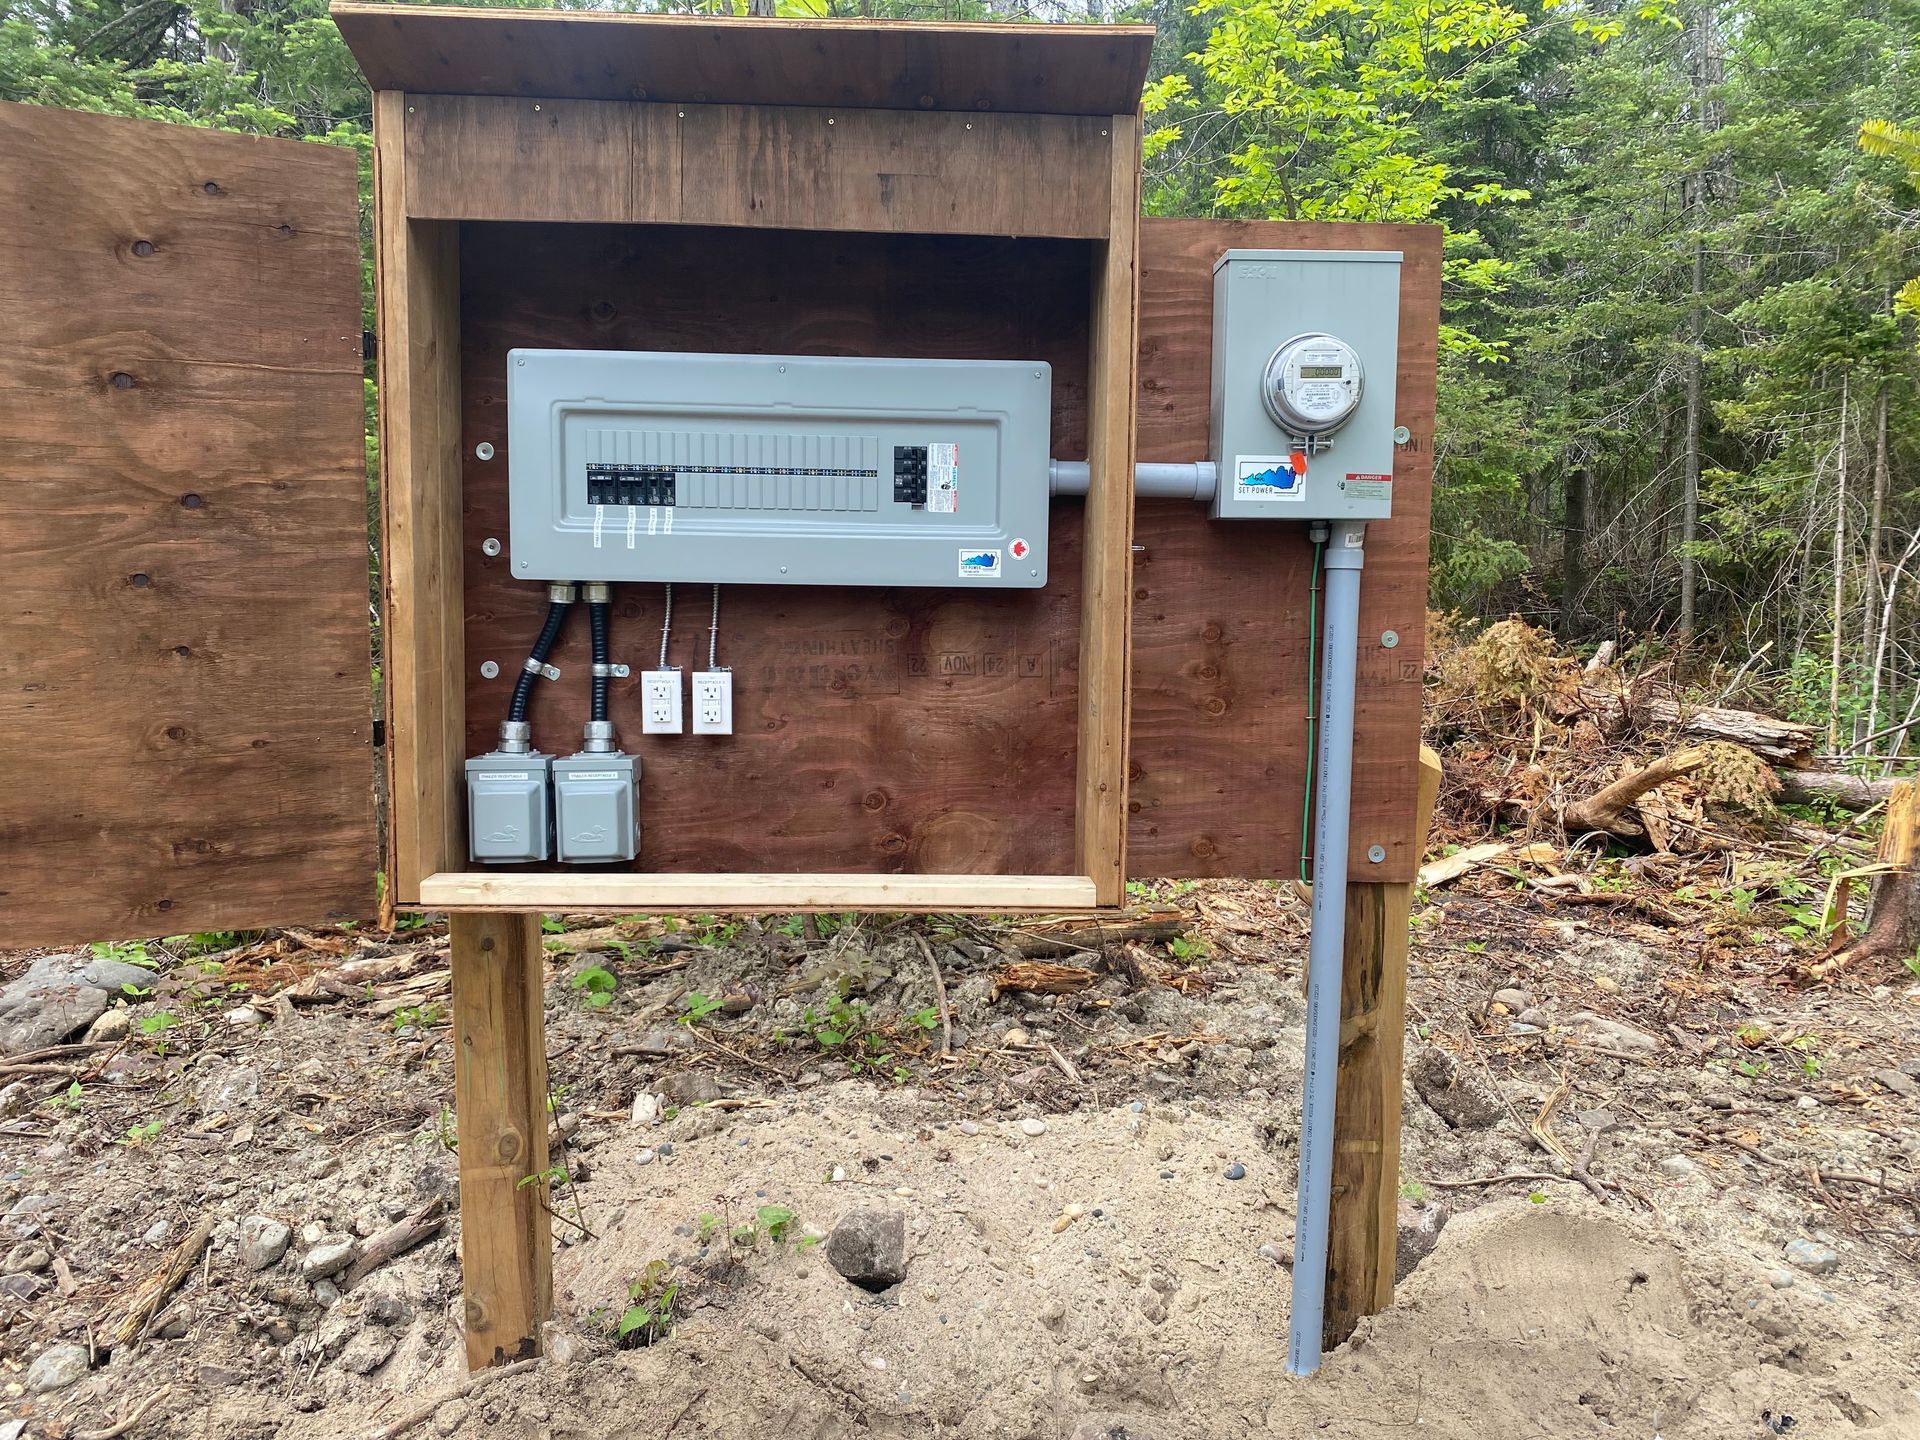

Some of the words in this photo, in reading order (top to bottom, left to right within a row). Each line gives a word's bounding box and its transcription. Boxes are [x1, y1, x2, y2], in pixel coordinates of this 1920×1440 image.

[1238, 486, 1251, 494] SET
[911, 657, 927, 673] 22
[944, 656, 971, 672] NOV
[987, 657, 1004, 672] 24
[1027, 658, 1036, 672] A
